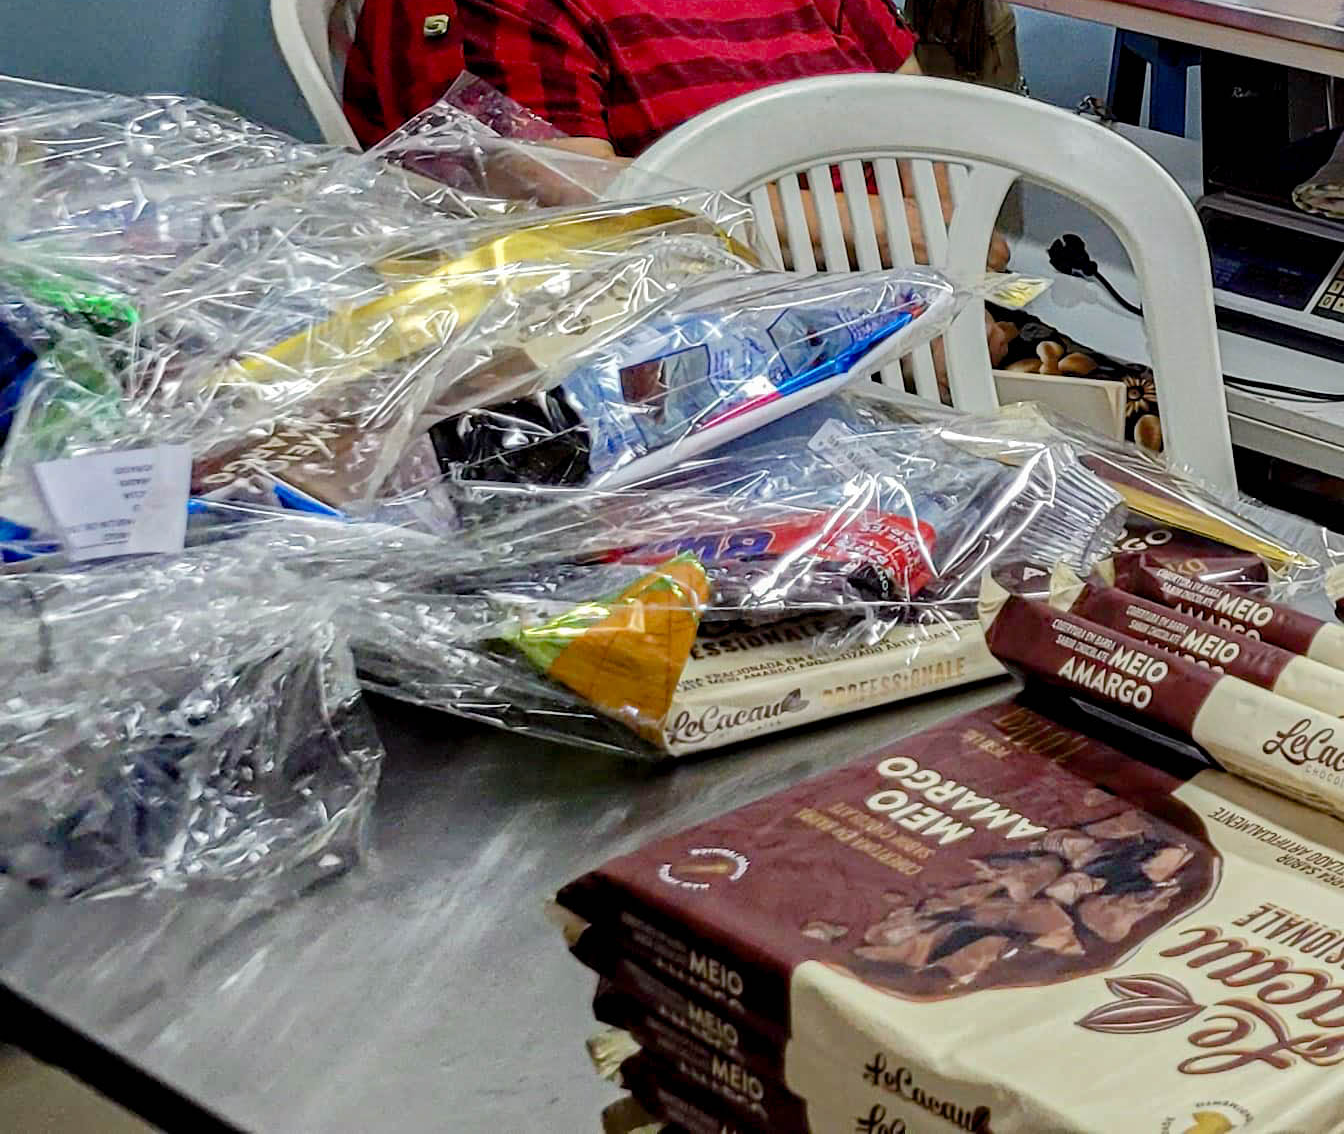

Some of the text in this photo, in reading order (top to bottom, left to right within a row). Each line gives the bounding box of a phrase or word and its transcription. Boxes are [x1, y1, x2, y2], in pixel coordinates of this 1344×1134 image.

[1215, 592, 1274, 627] MEIO
[1108, 644, 1169, 683] MEIO
[1180, 628, 1241, 664] MEIO
[1057, 656, 1153, 710] AMARGO
[865, 788, 977, 846] MEIO
[876, 755, 1049, 841] AMARGO
[1206, 805, 1312, 866] ARTIFICIALMENTE
[1273, 854, 1319, 877] SABOR
[689, 950, 744, 997] MEIO
[711, 1054, 765, 1102] MEIO
[862, 1052, 980, 1132] LeCacau
